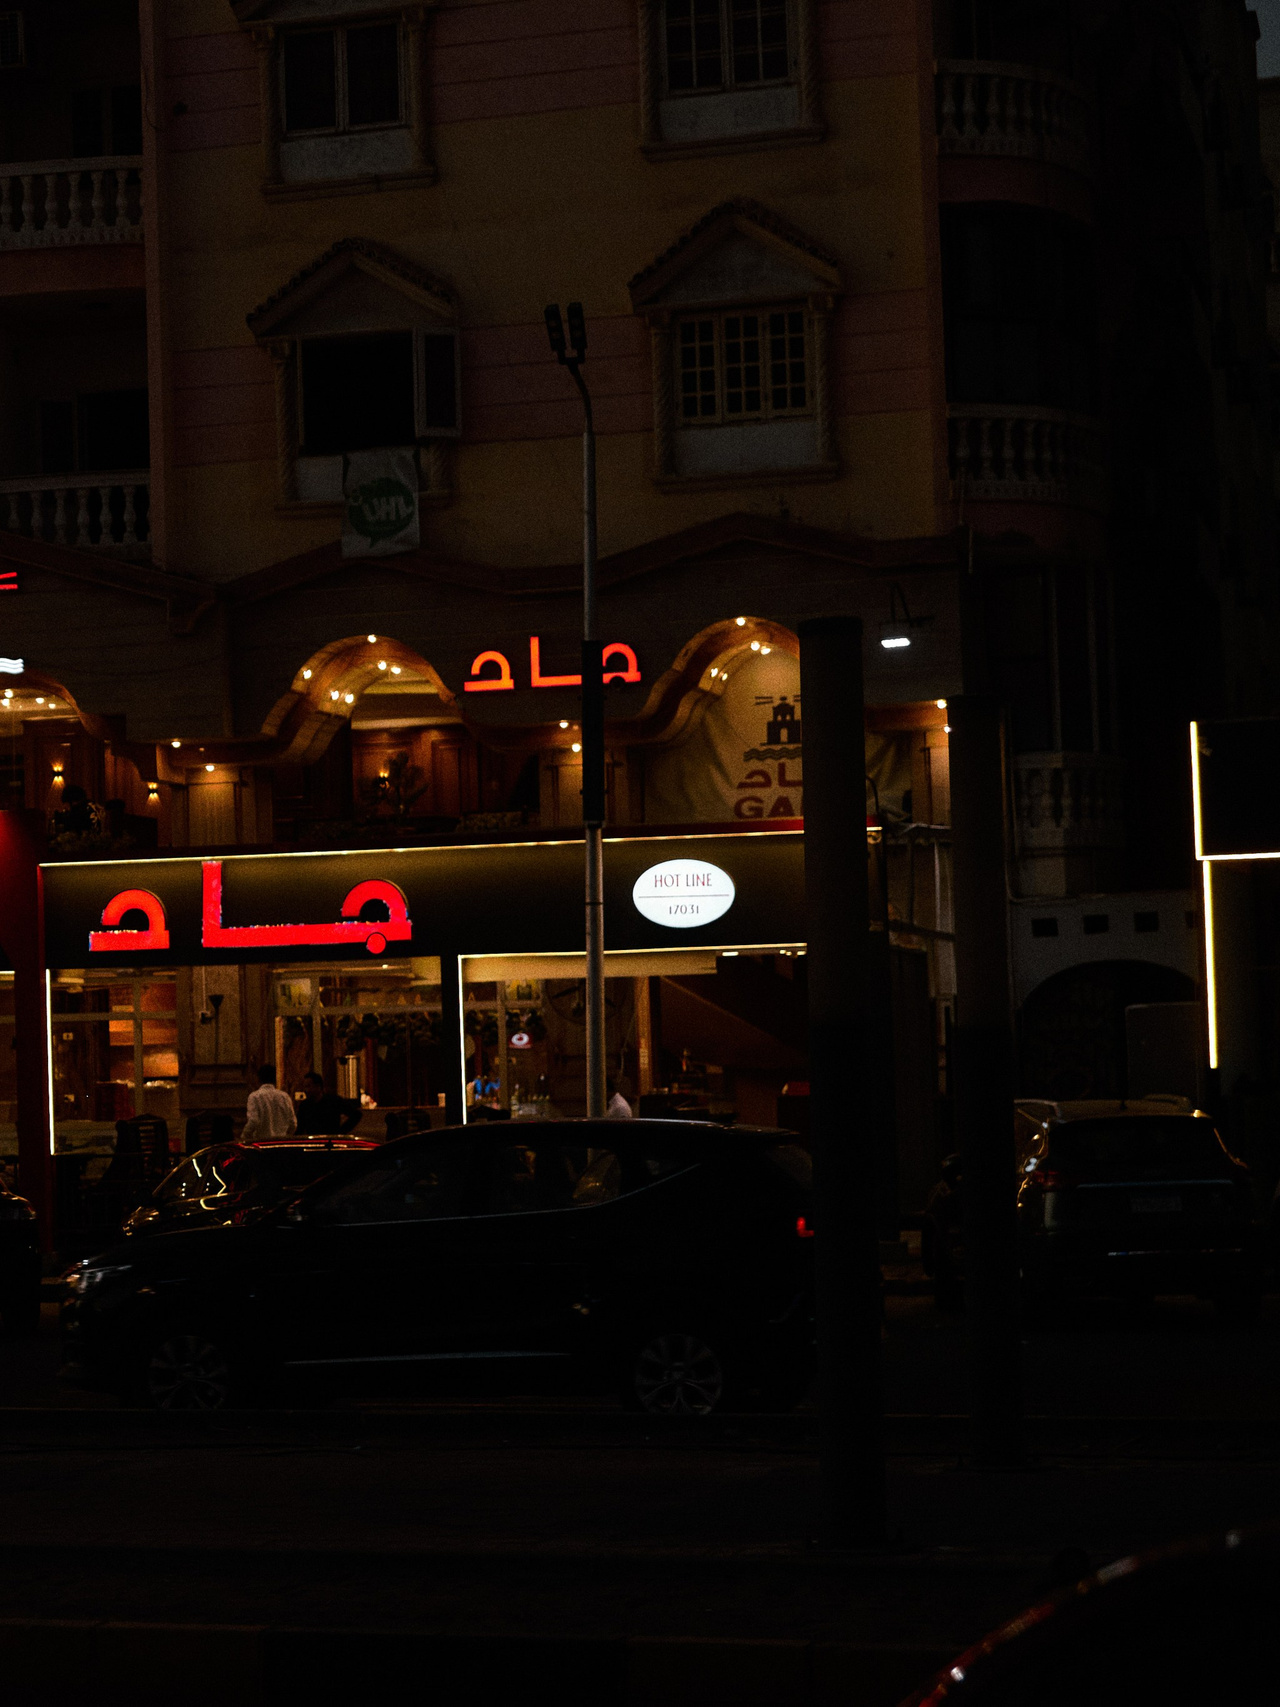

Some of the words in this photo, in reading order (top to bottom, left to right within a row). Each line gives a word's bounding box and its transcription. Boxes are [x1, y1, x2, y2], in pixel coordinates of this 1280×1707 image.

[736, 762, 803, 789] اد
[734, 795, 804, 819] GA
[654, 873, 681, 888] HOT
[685, 873, 712, 887] LINE
[89, 860, 413, 955] جاد
[668, 904, 700, 915] 17031
